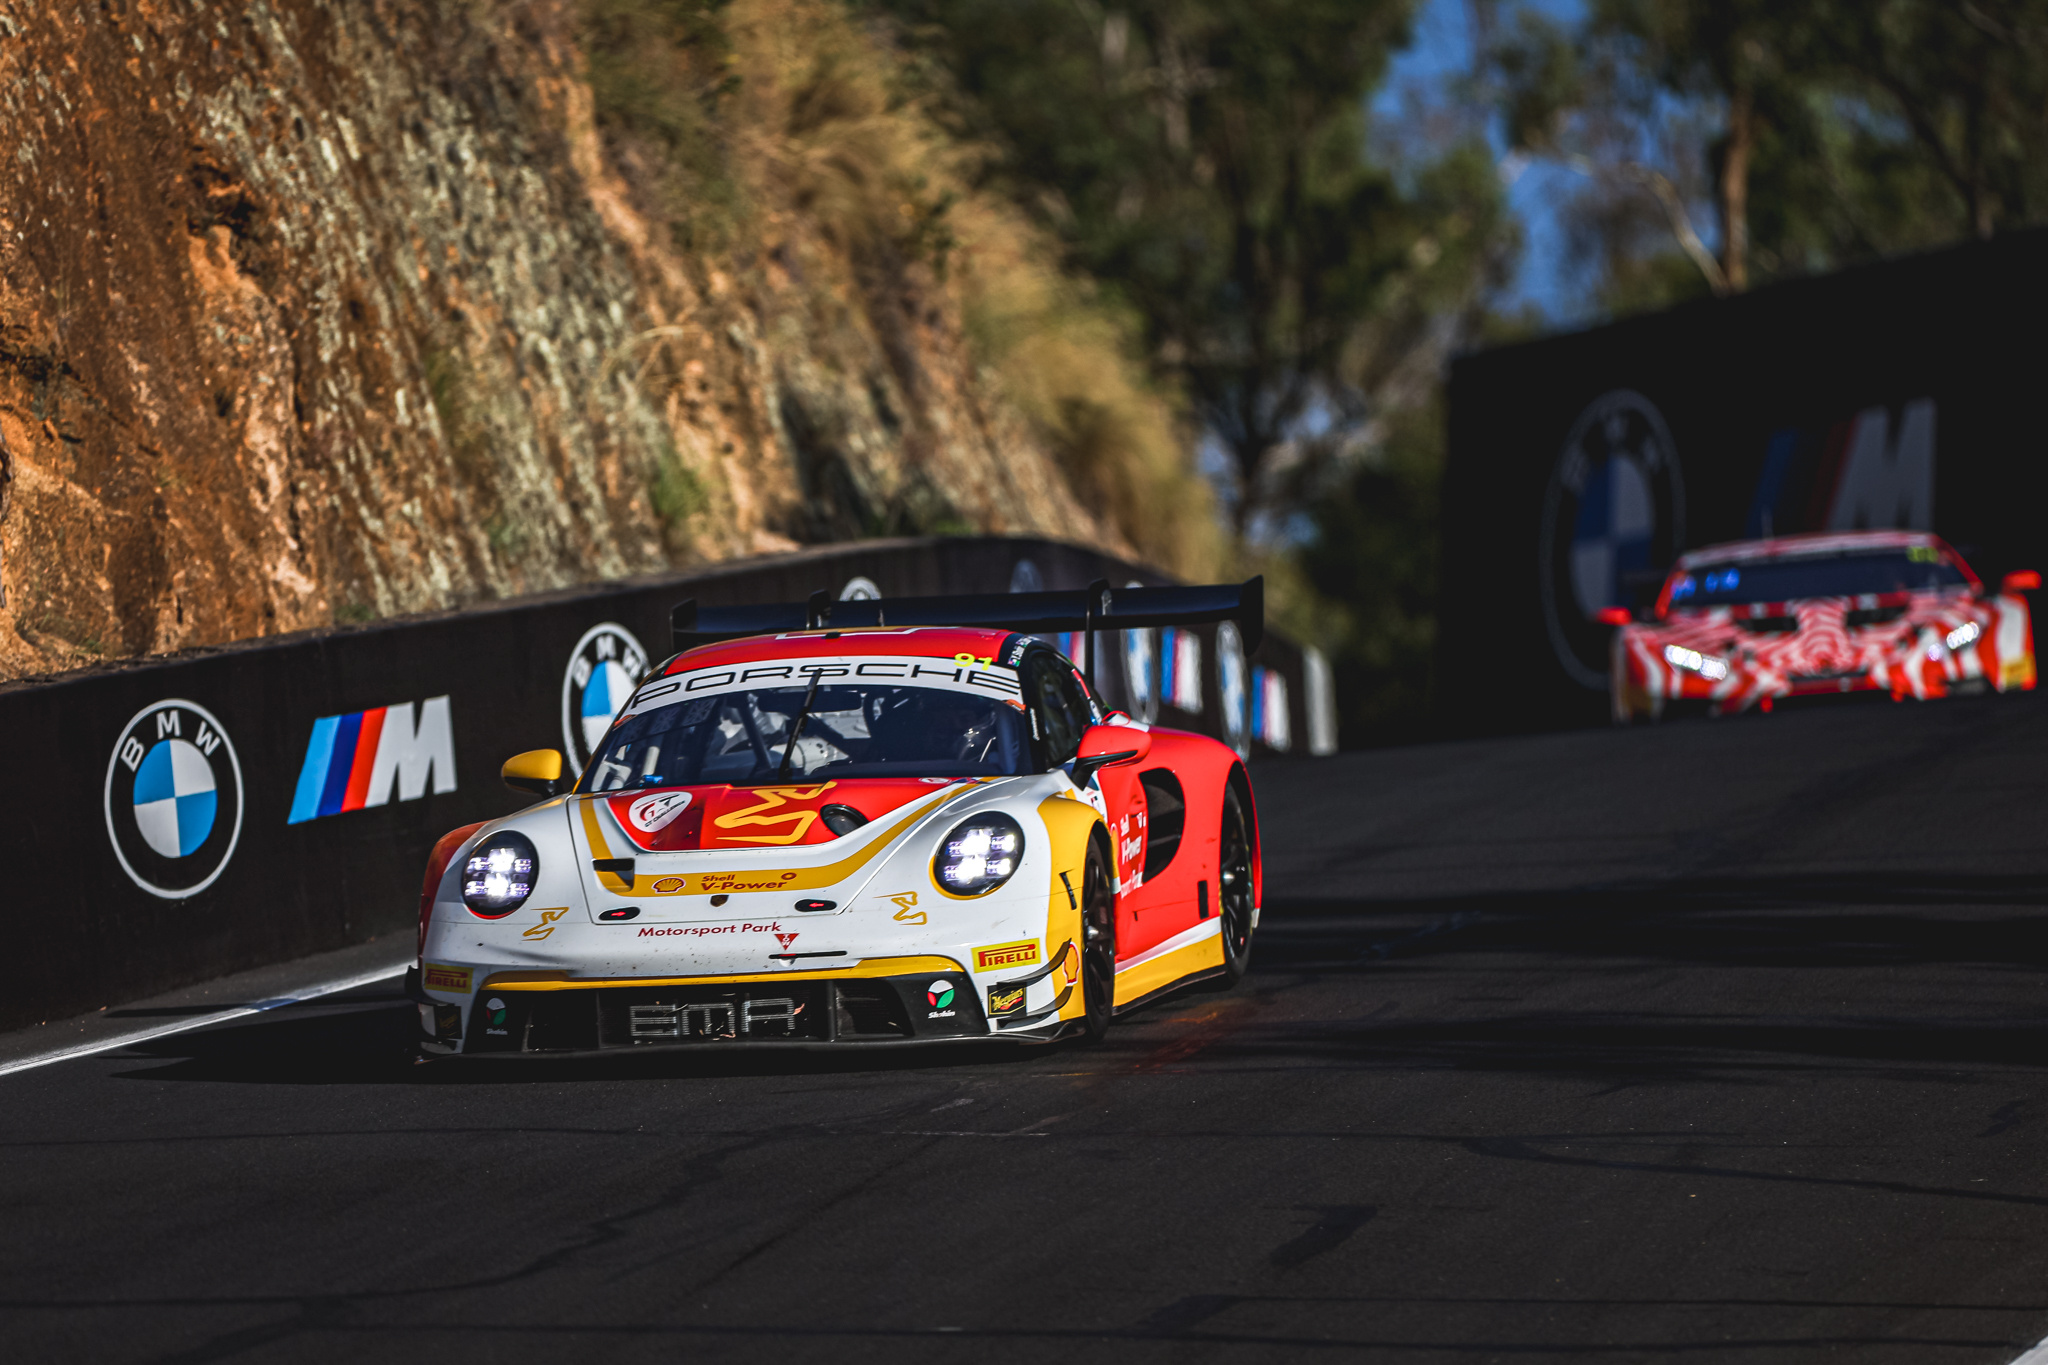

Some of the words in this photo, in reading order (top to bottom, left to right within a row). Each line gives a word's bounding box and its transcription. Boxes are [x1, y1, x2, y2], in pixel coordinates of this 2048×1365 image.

[572, 634, 641, 690] BMW
[953, 652, 993, 671] 91
[631, 663, 1021, 709] PORSCHE
[120, 709, 221, 773] BMW
[363, 694, 458, 808] M
[701, 881, 787, 891] V-Power
[702, 874, 735, 882] Shell
[638, 925, 736, 937] Motorsport
[742, 922, 782, 932] Park
[978, 944, 1036, 967] PIRELLI
[427, 969, 468, 988] PIRELLI
